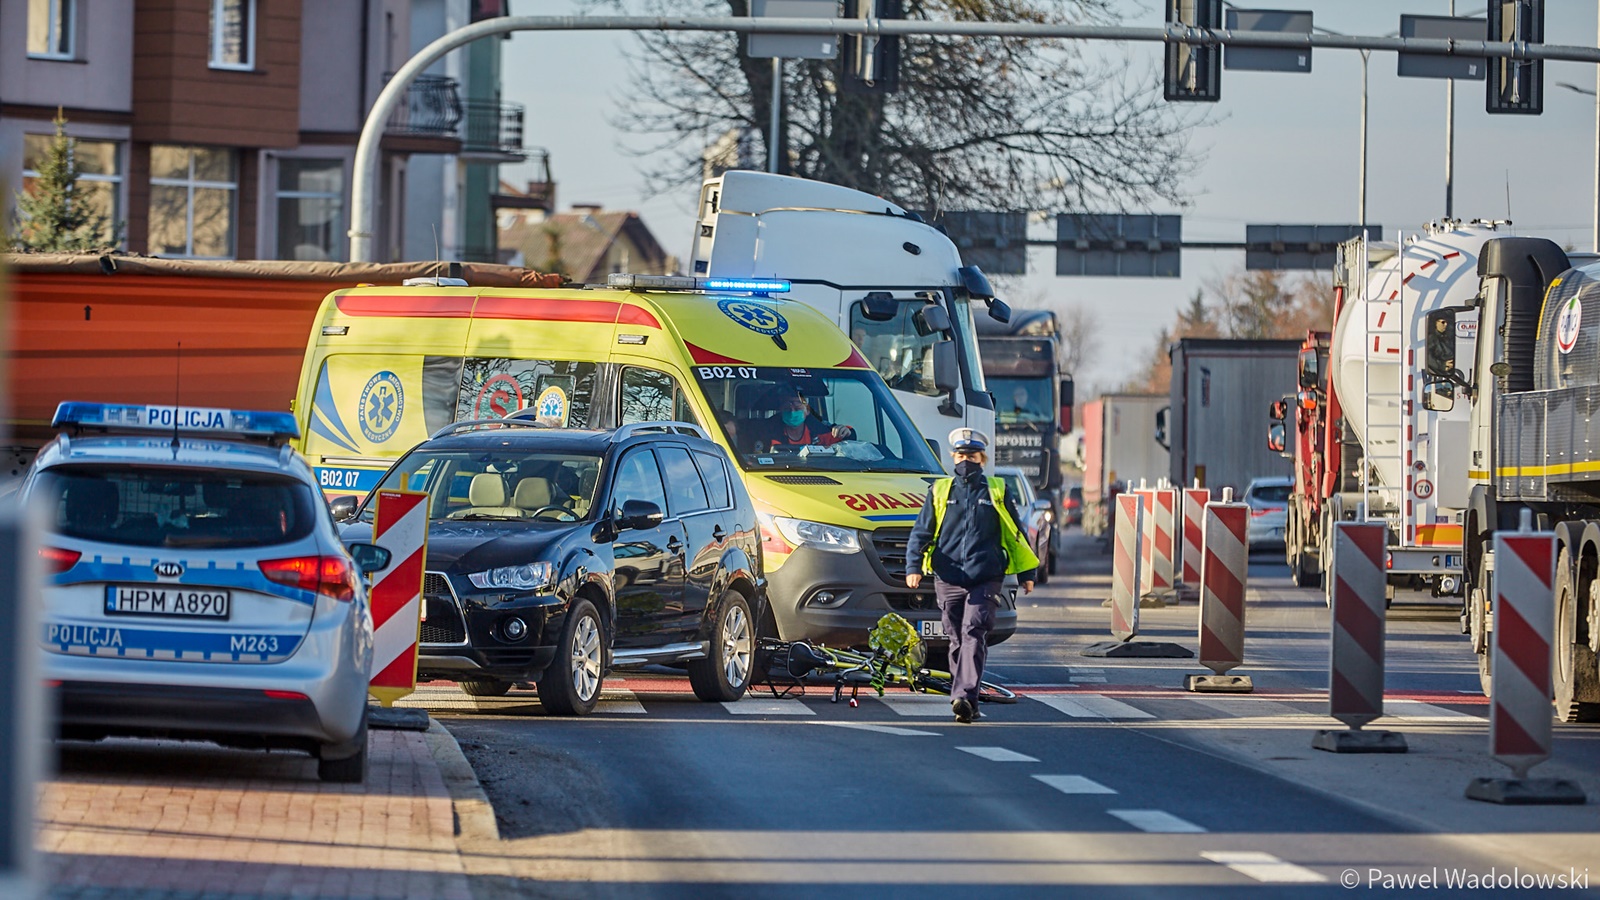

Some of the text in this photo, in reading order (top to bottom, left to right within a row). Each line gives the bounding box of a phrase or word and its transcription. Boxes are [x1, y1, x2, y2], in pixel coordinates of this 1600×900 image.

[698, 366, 757, 380] B02 07
[148, 408, 225, 429] POLICJA
[321, 469, 360, 488] B02 07
[1418, 484, 1430, 494] 70
[158, 564, 180, 575] KIA
[119, 590, 166, 612] HPM
[174, 592, 226, 615] A890
[48, 624, 123, 647] POLICJA
[924, 622, 938, 636] BL
[231, 636, 279, 652] M263
